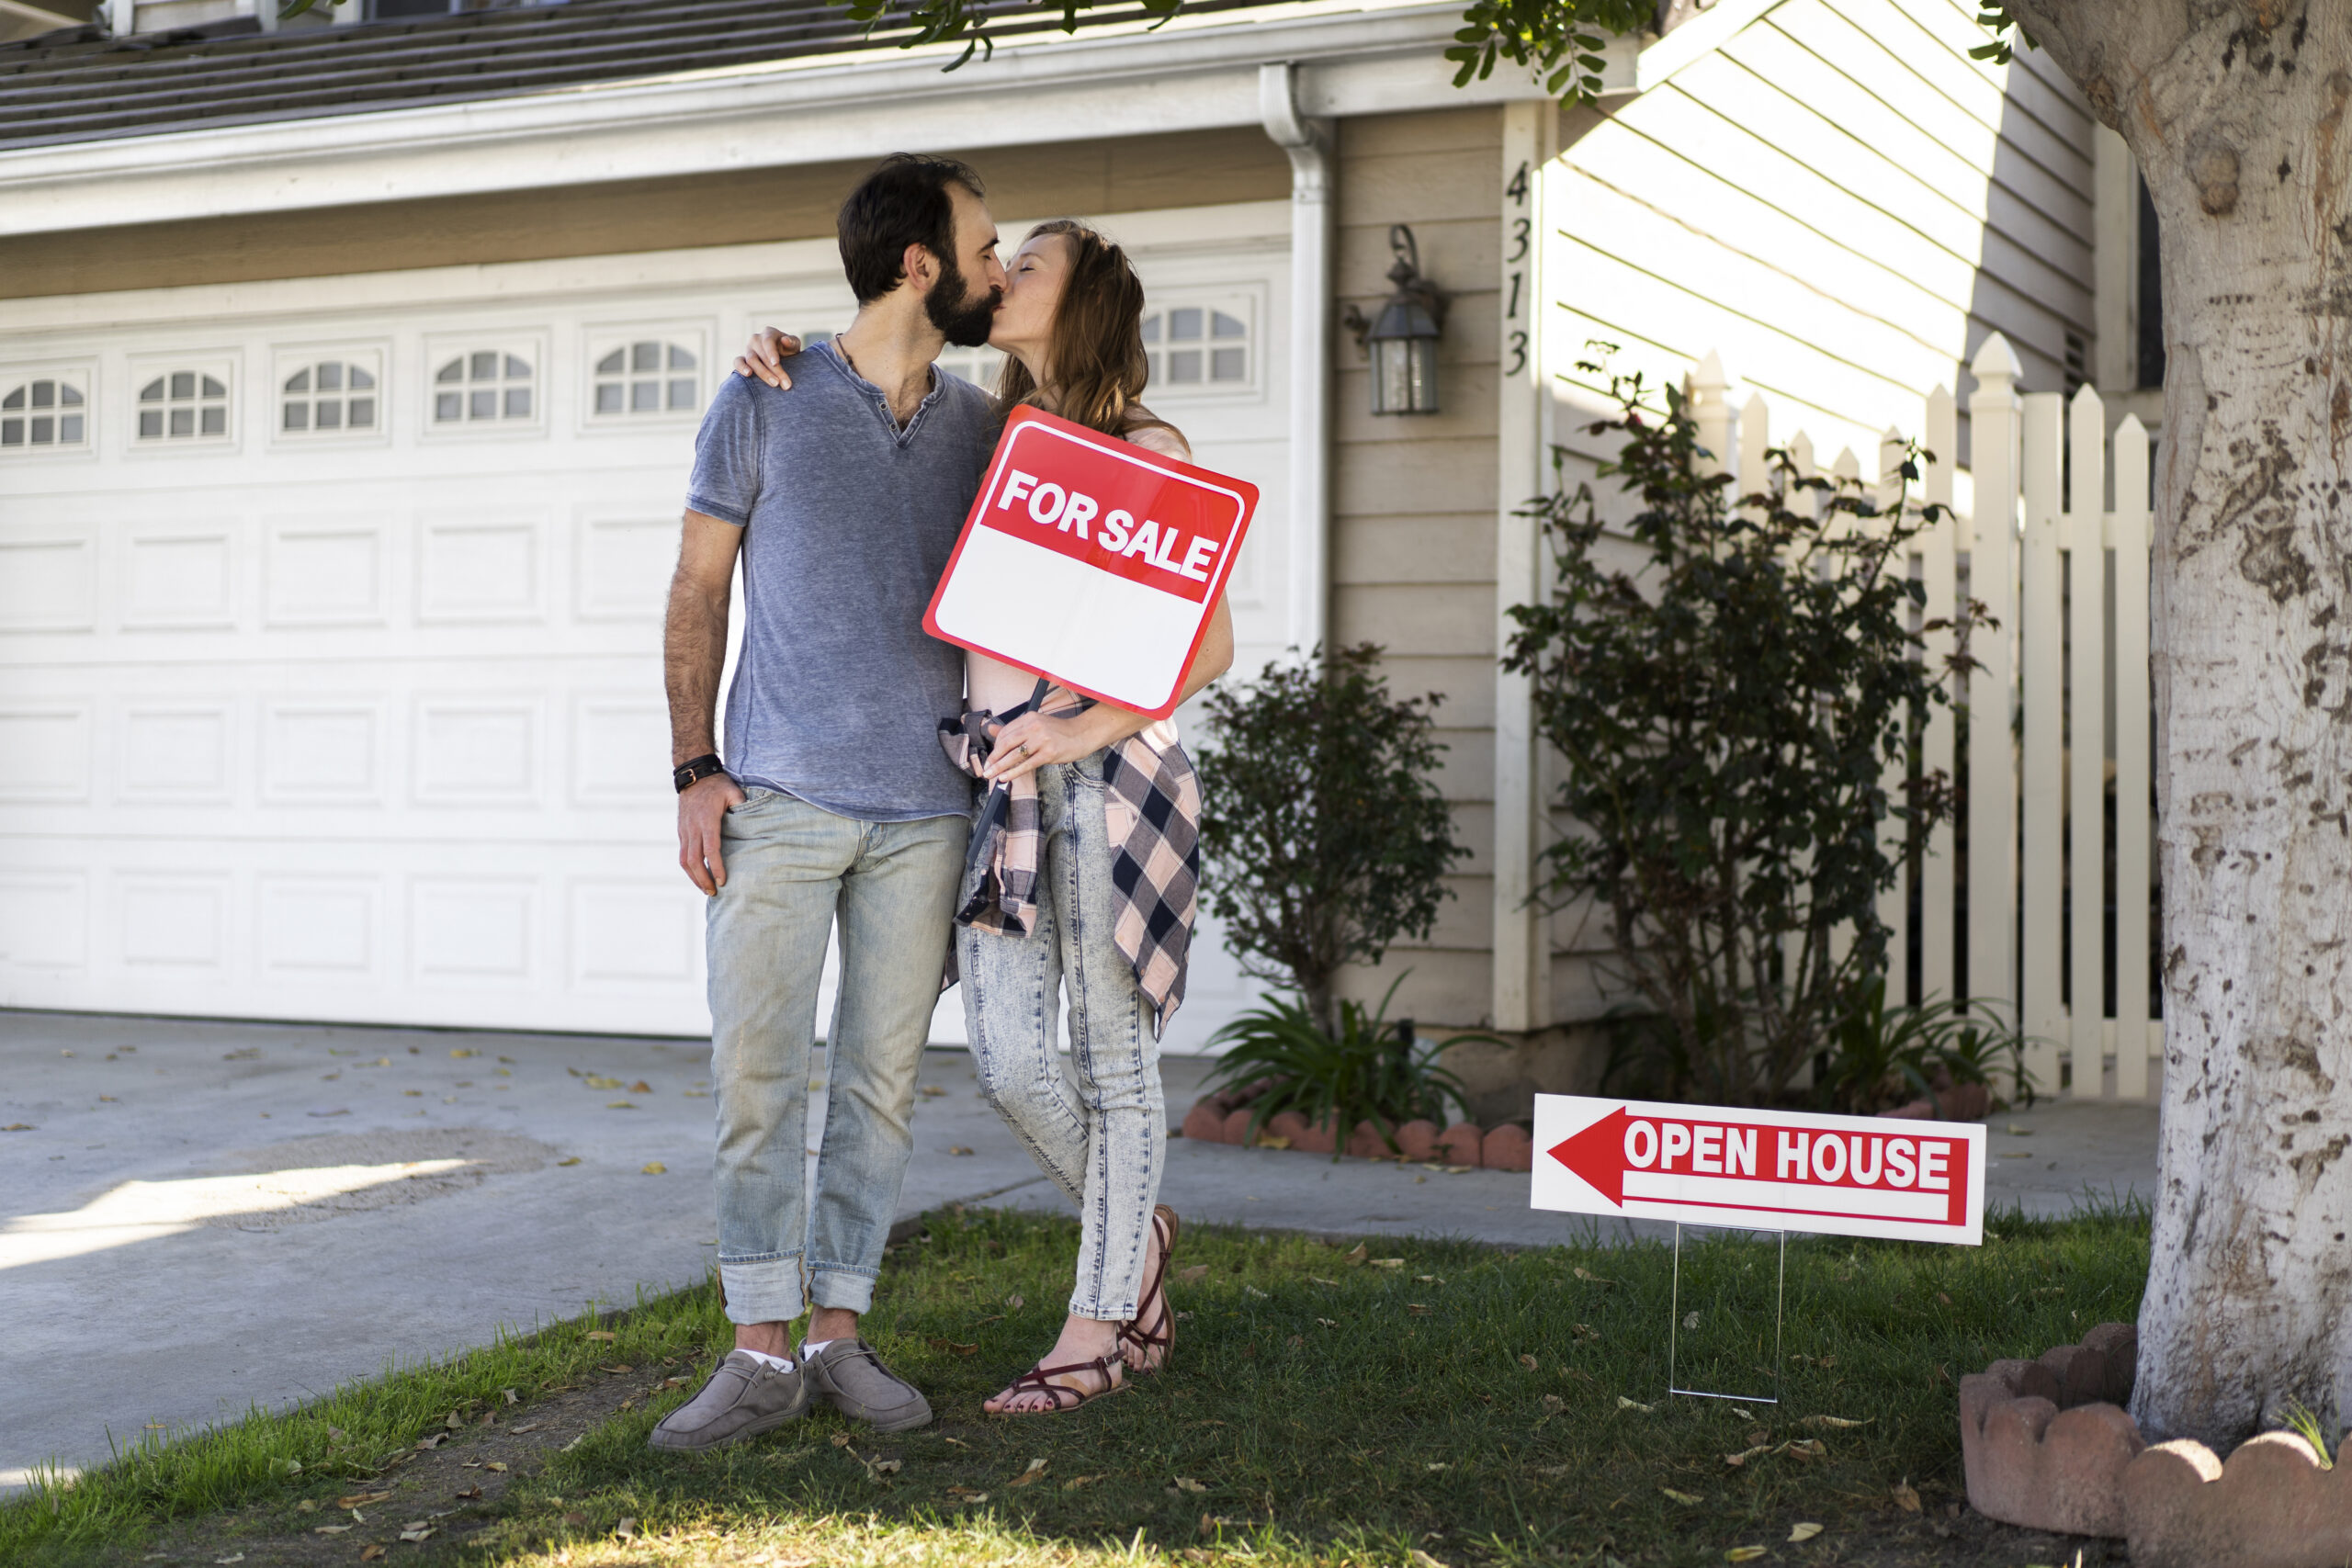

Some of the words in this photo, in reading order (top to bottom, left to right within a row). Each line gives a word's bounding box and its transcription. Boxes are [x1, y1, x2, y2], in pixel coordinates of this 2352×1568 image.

[1505, 160, 1532, 378] 4313
[997, 468, 1099, 540] FOR
[1097, 509, 1220, 583] SALE
[1623, 1120, 1758, 1177] OPEN
[1776, 1131, 1951, 1190] HOUSE
